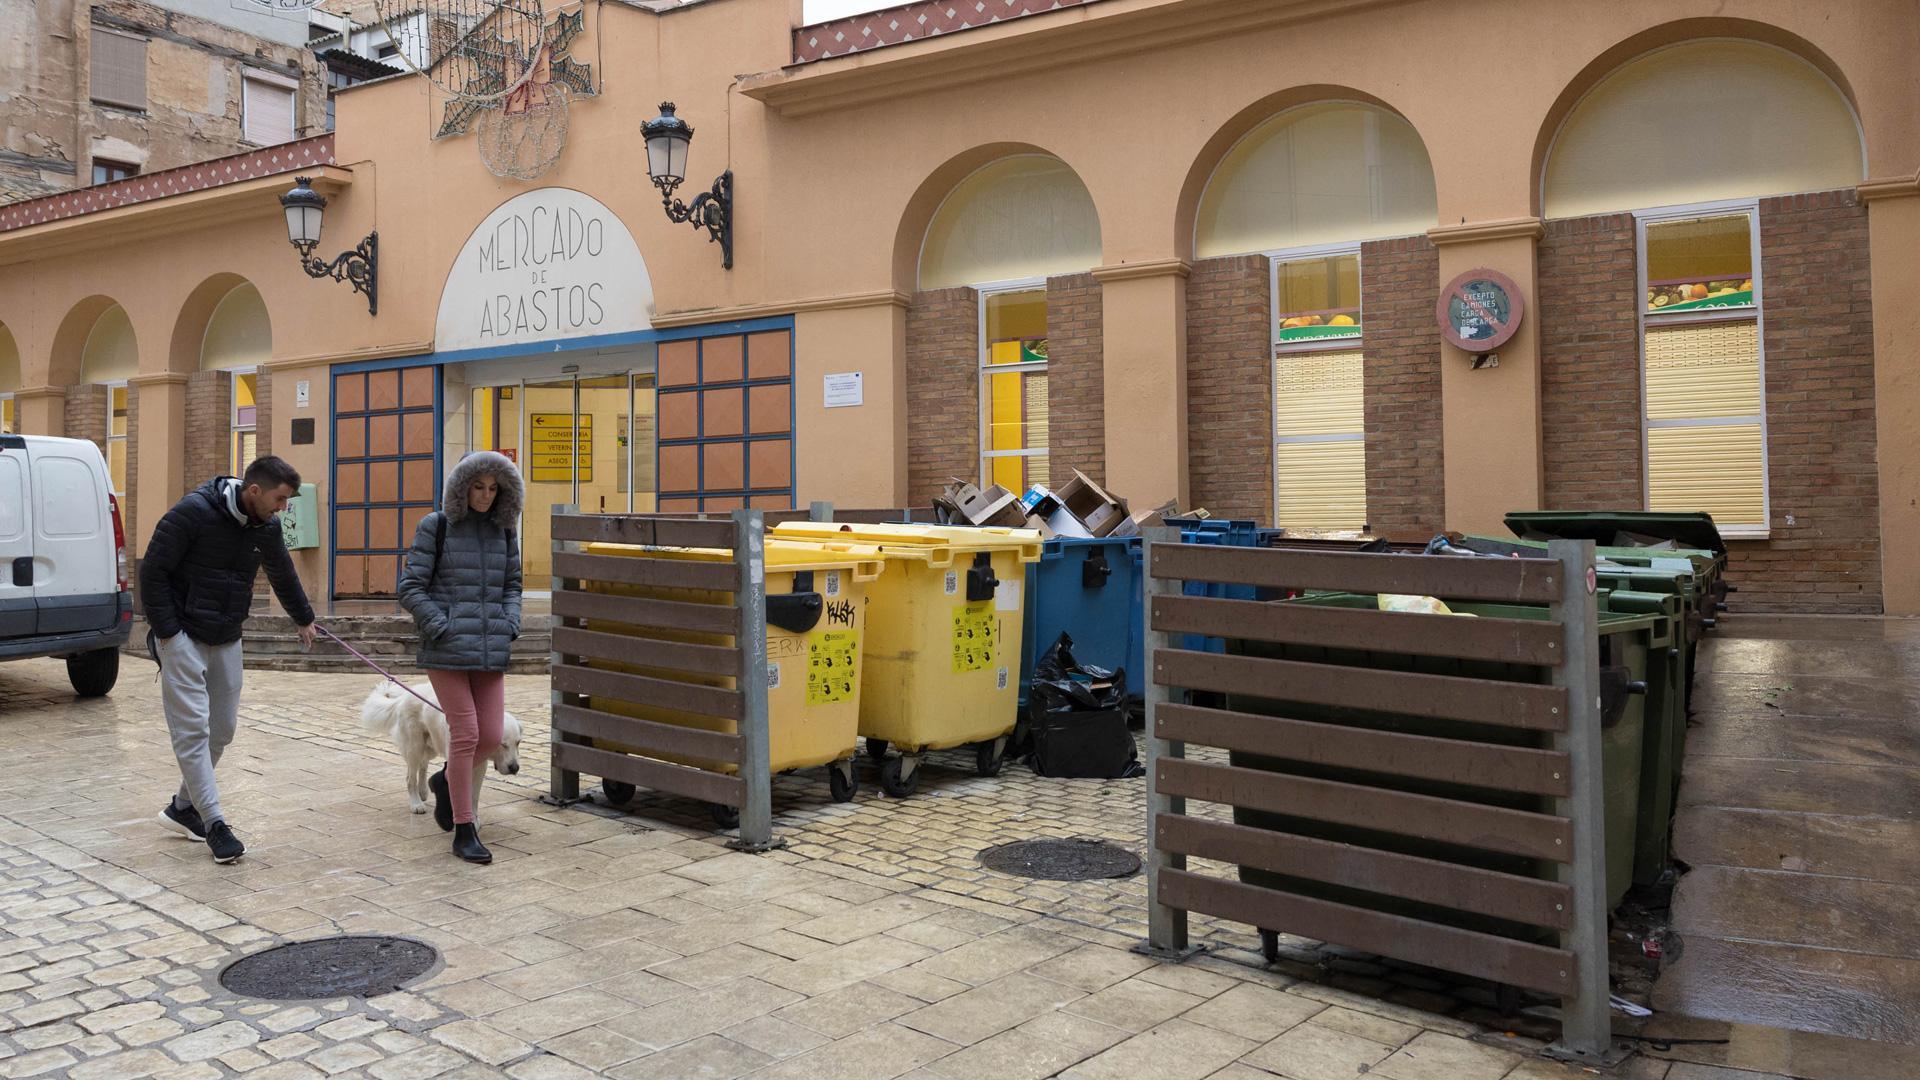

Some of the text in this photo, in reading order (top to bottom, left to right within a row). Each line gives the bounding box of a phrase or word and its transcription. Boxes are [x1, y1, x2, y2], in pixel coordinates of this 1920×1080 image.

[479, 205, 603, 274] MERCADO
[532, 270, 547, 285] DE
[479, 282, 604, 338] ABASTOS
[1463, 292, 1495, 300] EXCEPTO
